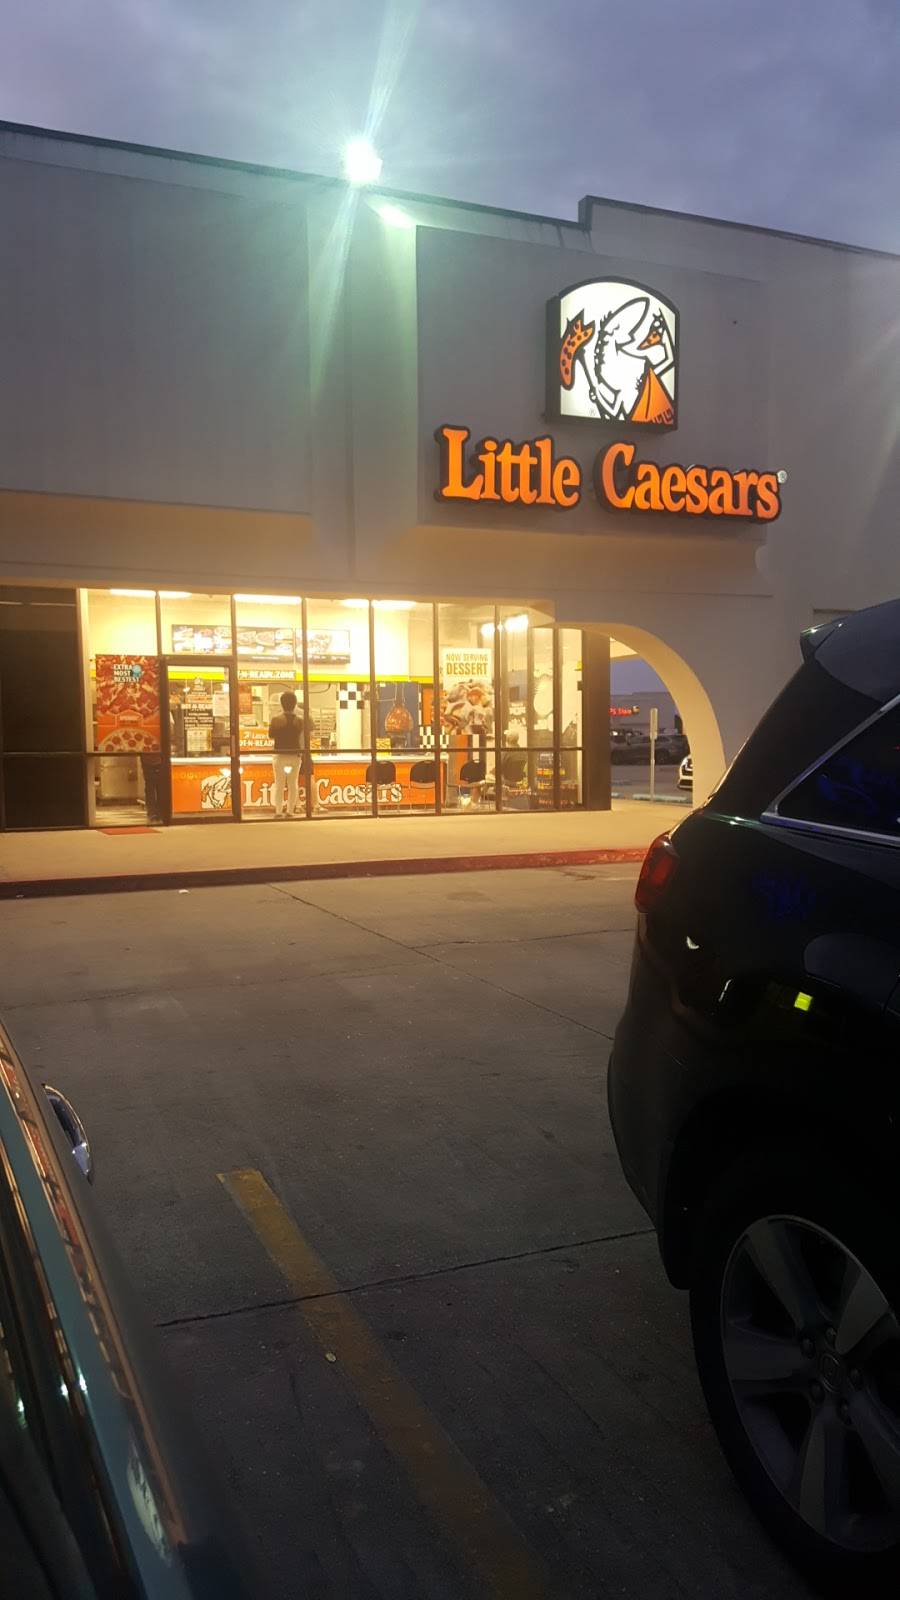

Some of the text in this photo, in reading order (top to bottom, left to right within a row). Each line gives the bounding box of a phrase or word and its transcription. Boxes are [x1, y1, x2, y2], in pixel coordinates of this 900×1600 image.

[441, 427, 780, 520] Little Caesars
[446, 653, 489, 662] NOW SERVING
[446, 662, 489, 675] DESSERT
